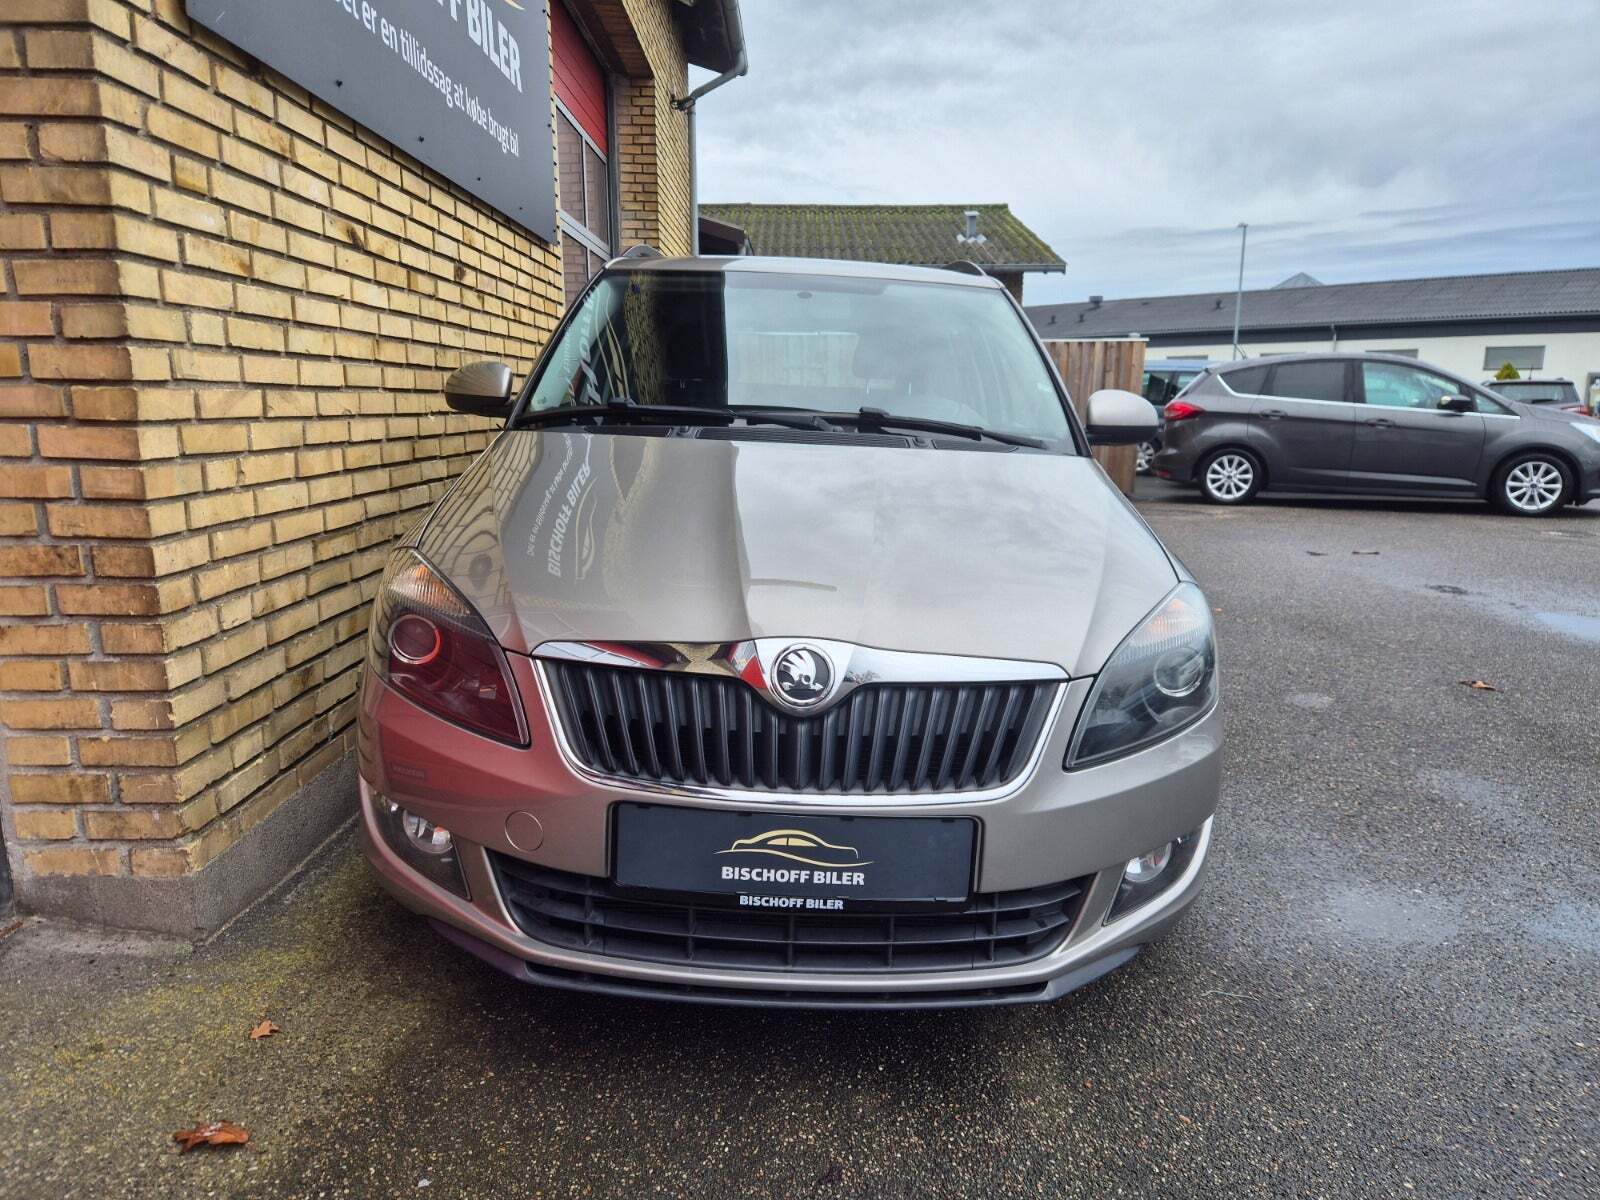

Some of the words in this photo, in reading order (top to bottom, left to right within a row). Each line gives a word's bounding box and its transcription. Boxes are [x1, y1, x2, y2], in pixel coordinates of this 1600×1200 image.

[466, 0, 522, 93] BILER
[361, 0, 377, 35] er
[380, 17, 399, 53] en
[400, 28, 453, 108] tillidssag
[454, 83, 465, 111] at
[465, 87, 487, 131] købe
[488, 107, 510, 154] brugt
[510, 128, 519, 157] bil
[721, 866, 810, 884] BISCHOFF
[812, 870, 865, 886] BILER
[739, 895, 804, 908] BISCHOFF
[805, 898, 844, 910] BILER
